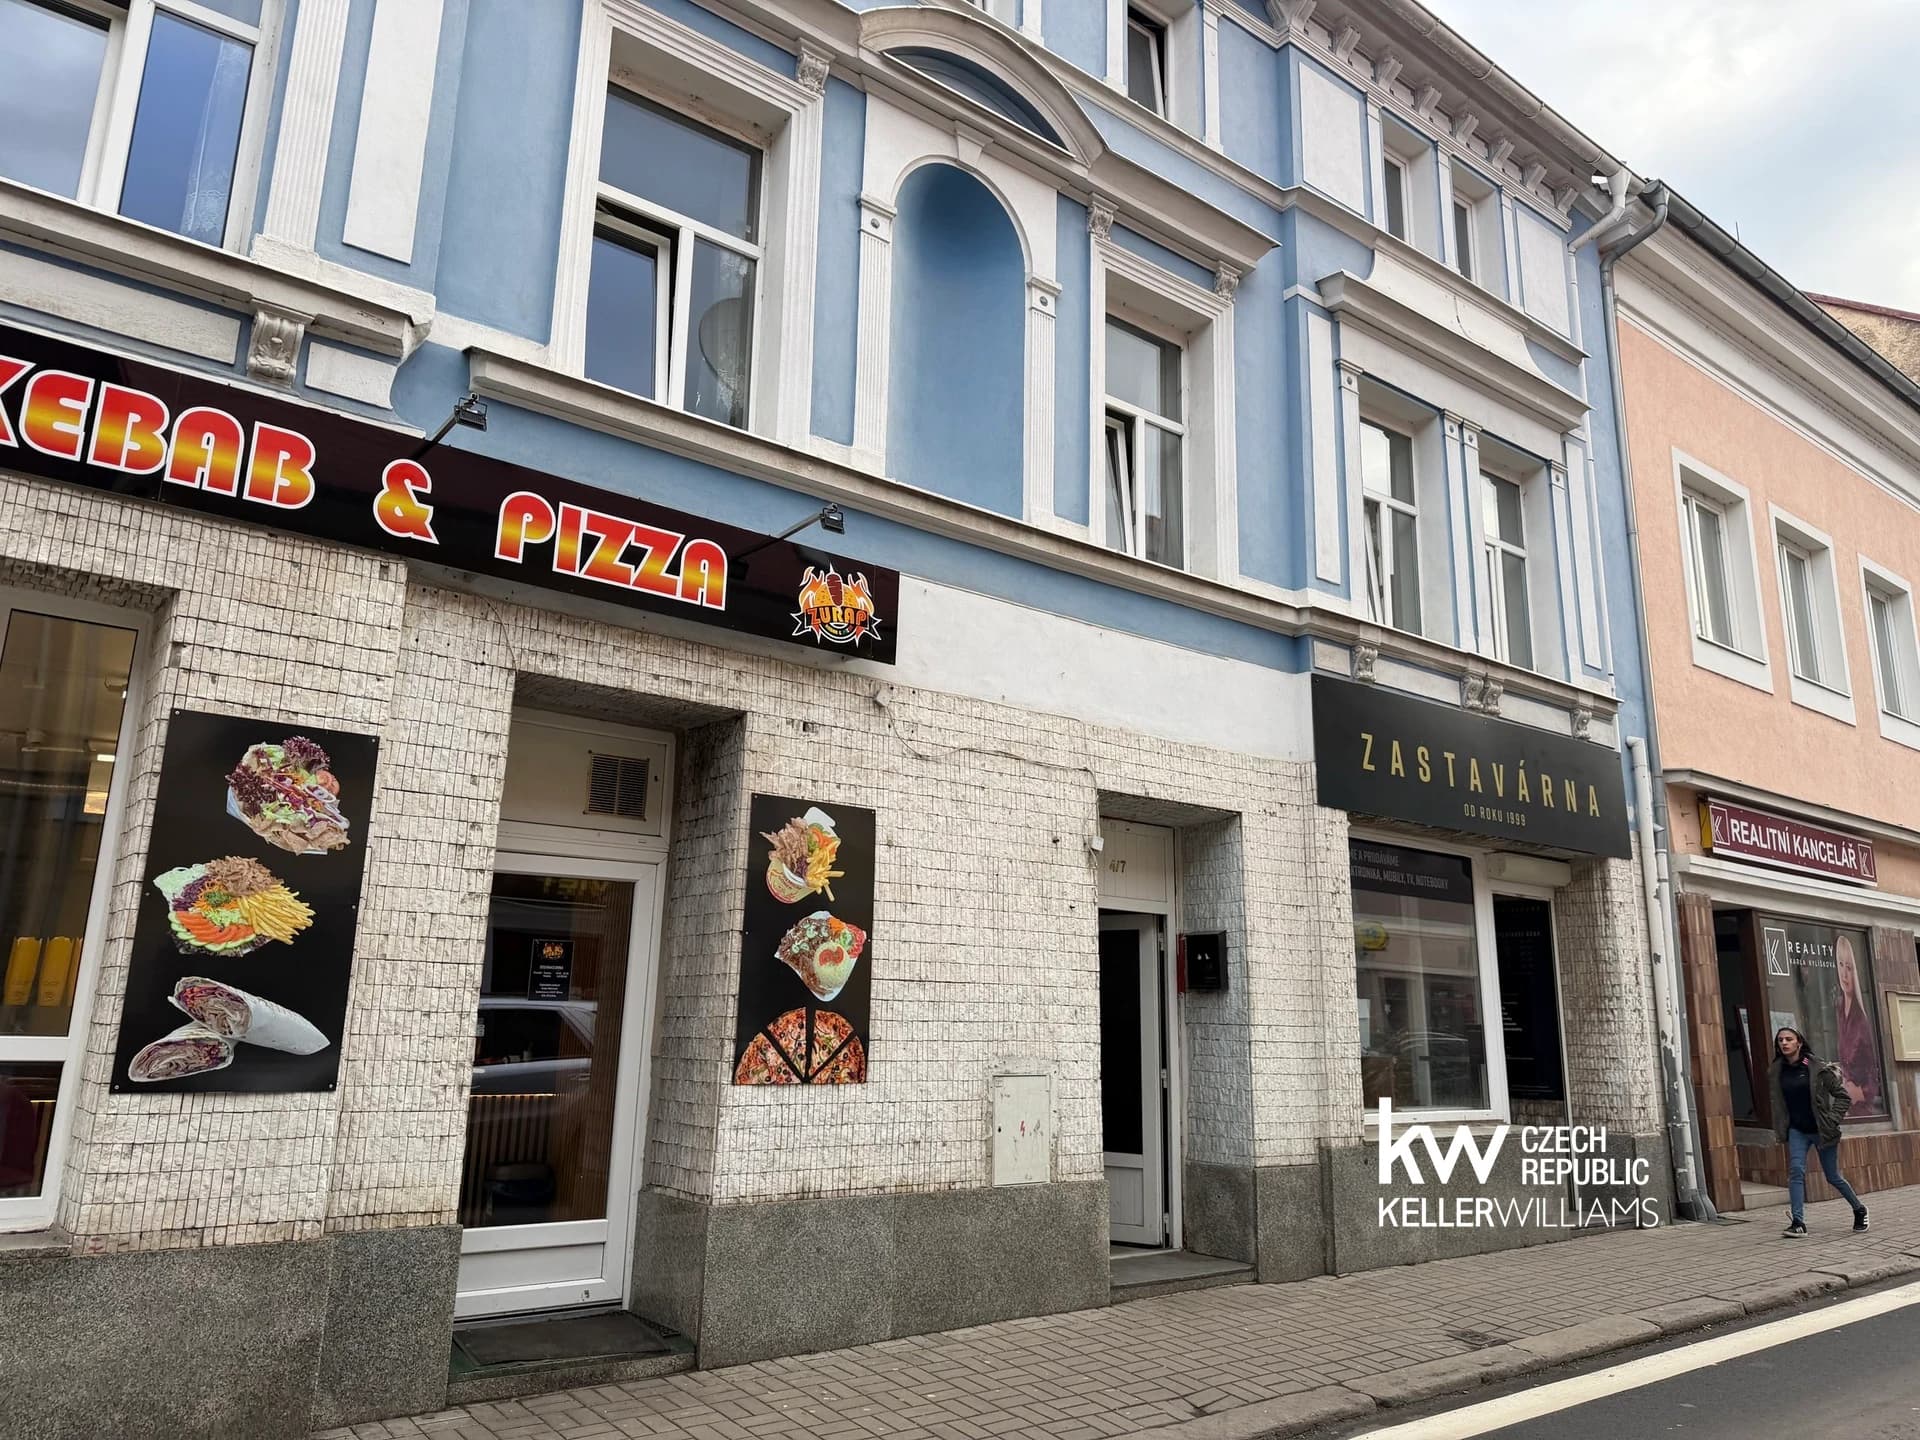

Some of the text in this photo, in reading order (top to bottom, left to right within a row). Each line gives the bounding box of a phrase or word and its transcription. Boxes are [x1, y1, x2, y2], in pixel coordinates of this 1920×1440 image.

[373, 458, 440, 545] &
[494, 490, 728, 612] PIZZA
[807, 606, 868, 626] ZURAP
[1360, 732, 1601, 818] ZASTAVÁRNA
[1463, 803, 1527, 827] OD ROKU 1999
[1729, 817, 1791, 854] REALITNÍ
[1792, 833, 1858, 870] KANCELÁŘ
[1787, 941, 1834, 956] REALITY
